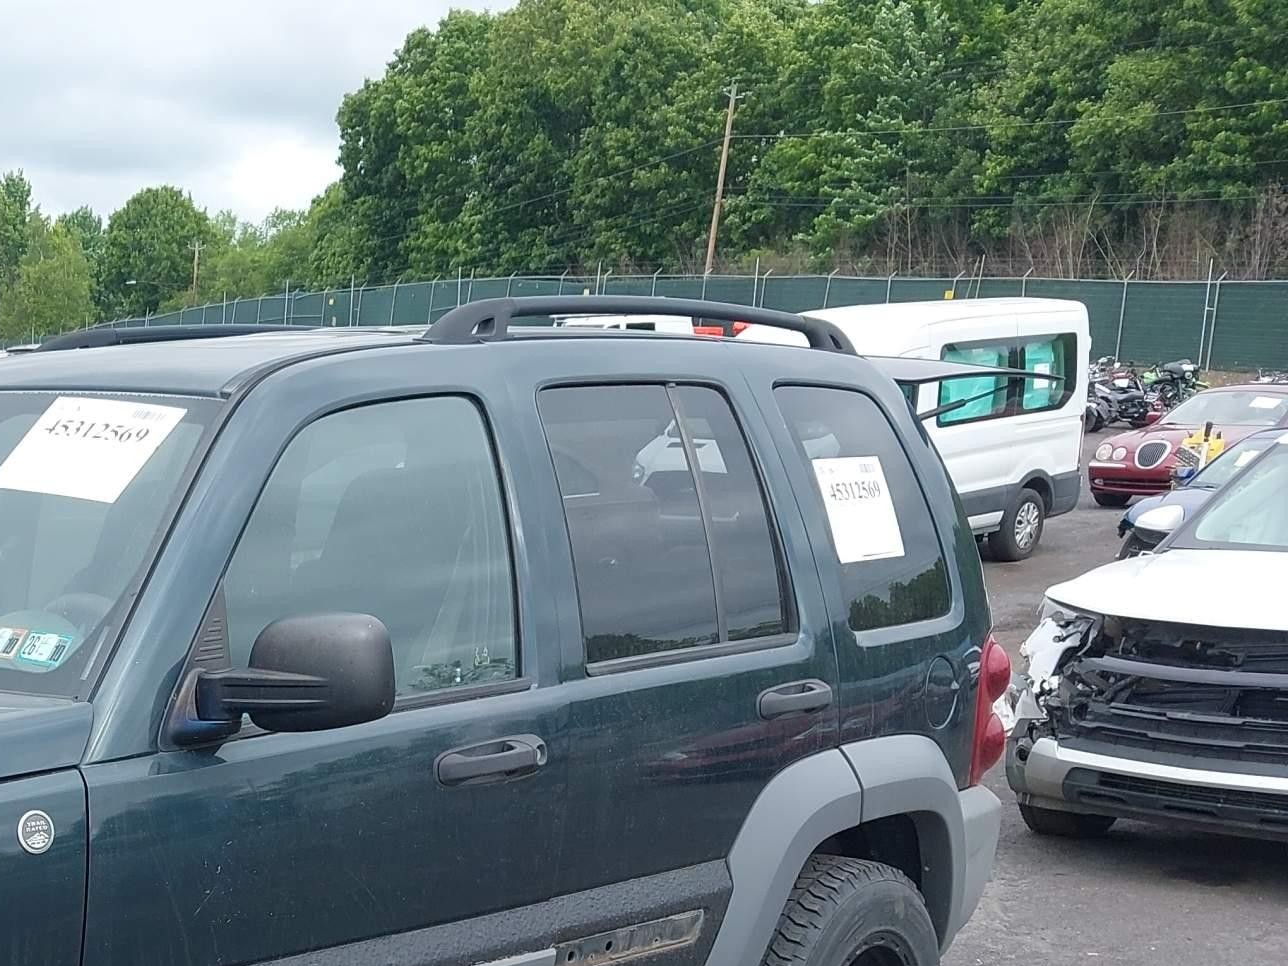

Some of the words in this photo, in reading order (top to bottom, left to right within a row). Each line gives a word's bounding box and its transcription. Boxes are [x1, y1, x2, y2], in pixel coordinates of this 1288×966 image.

[44, 418, 150, 442] 45312569
[830, 480, 880, 501] 45312569
[22, 635, 41, 655] 26
